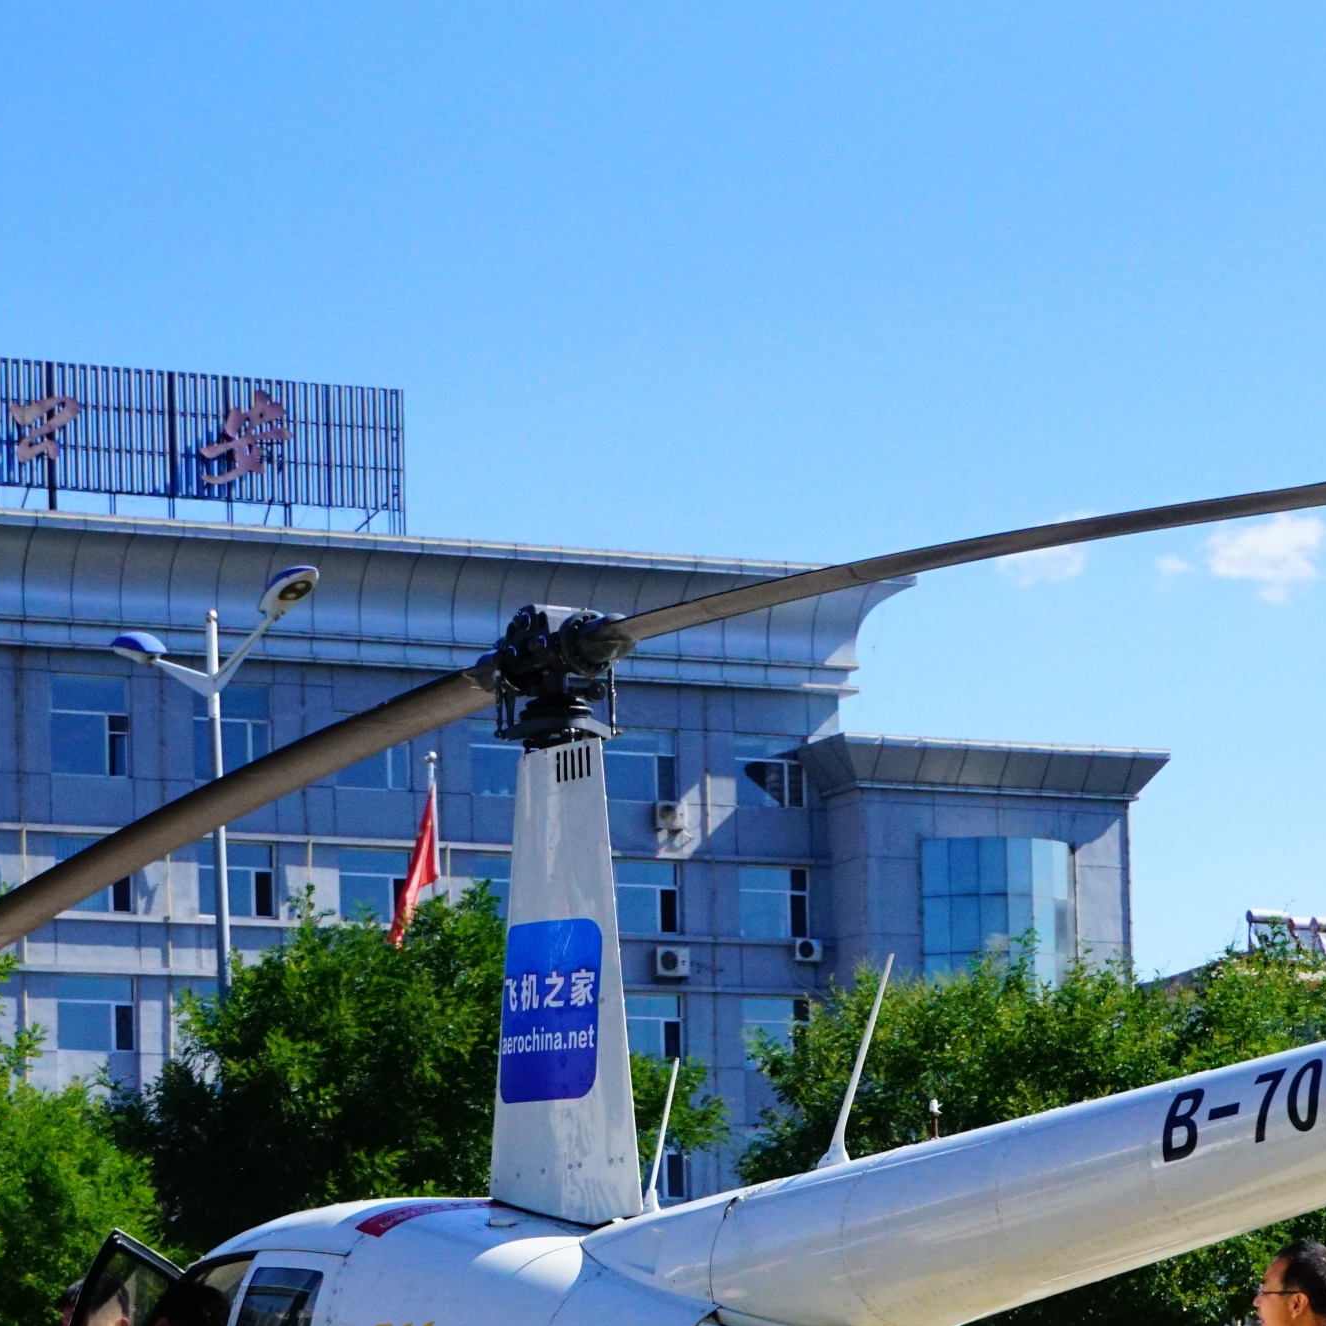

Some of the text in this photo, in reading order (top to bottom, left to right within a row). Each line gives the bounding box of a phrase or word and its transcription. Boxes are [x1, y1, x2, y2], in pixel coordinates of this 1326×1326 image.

[505, 968, 595, 1011] 飞机之家
[502, 1024, 595, 1055] aerochina.net
